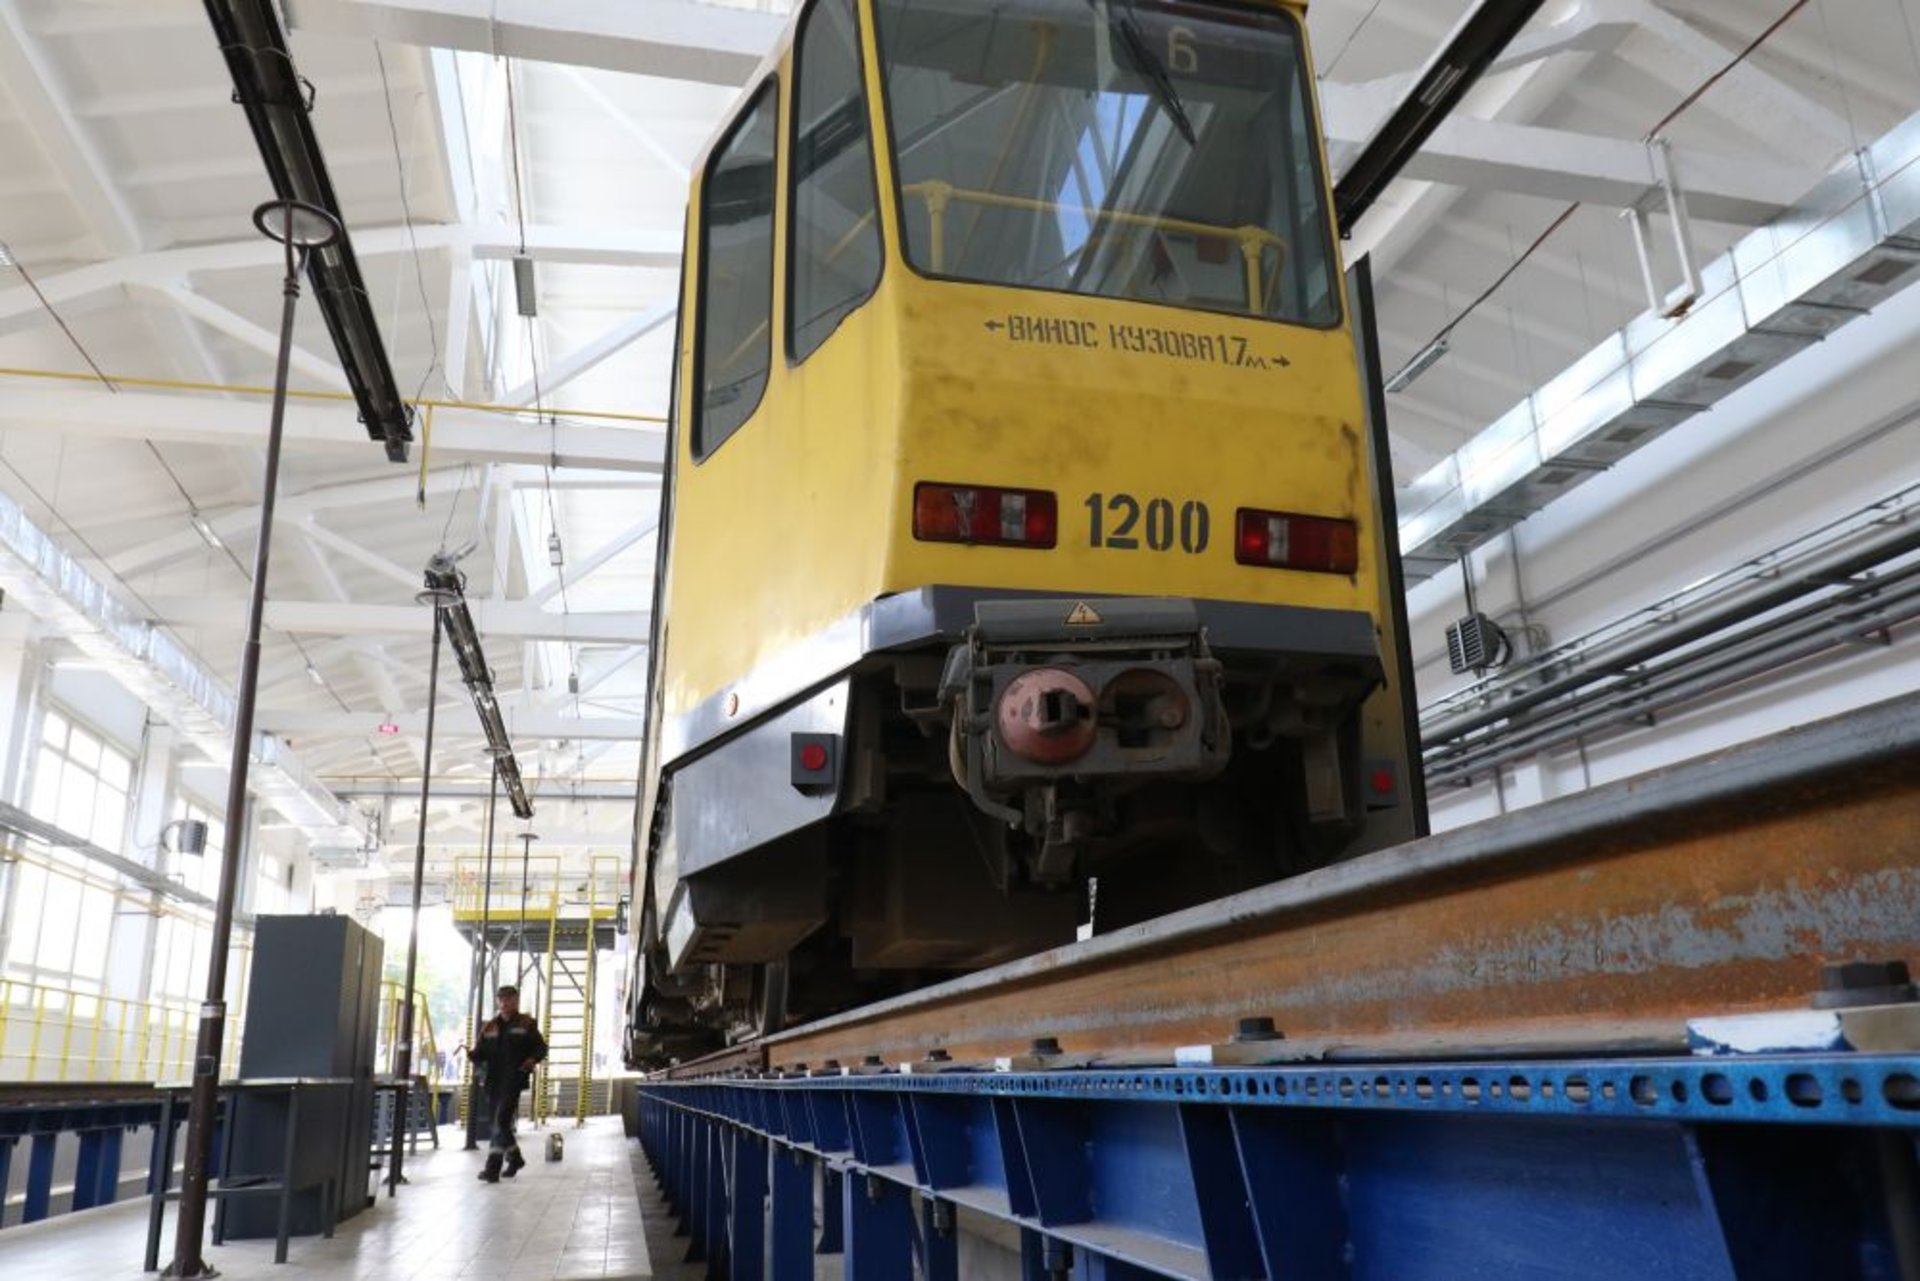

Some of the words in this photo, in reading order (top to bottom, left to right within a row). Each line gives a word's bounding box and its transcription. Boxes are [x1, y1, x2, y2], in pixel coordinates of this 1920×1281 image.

[1167, 26, 1198, 73] 6
[1007, 313, 1098, 348] ВИНОС
[1109, 323, 1215, 362] КУЗОВА
[1084, 492, 1210, 554] 1200
